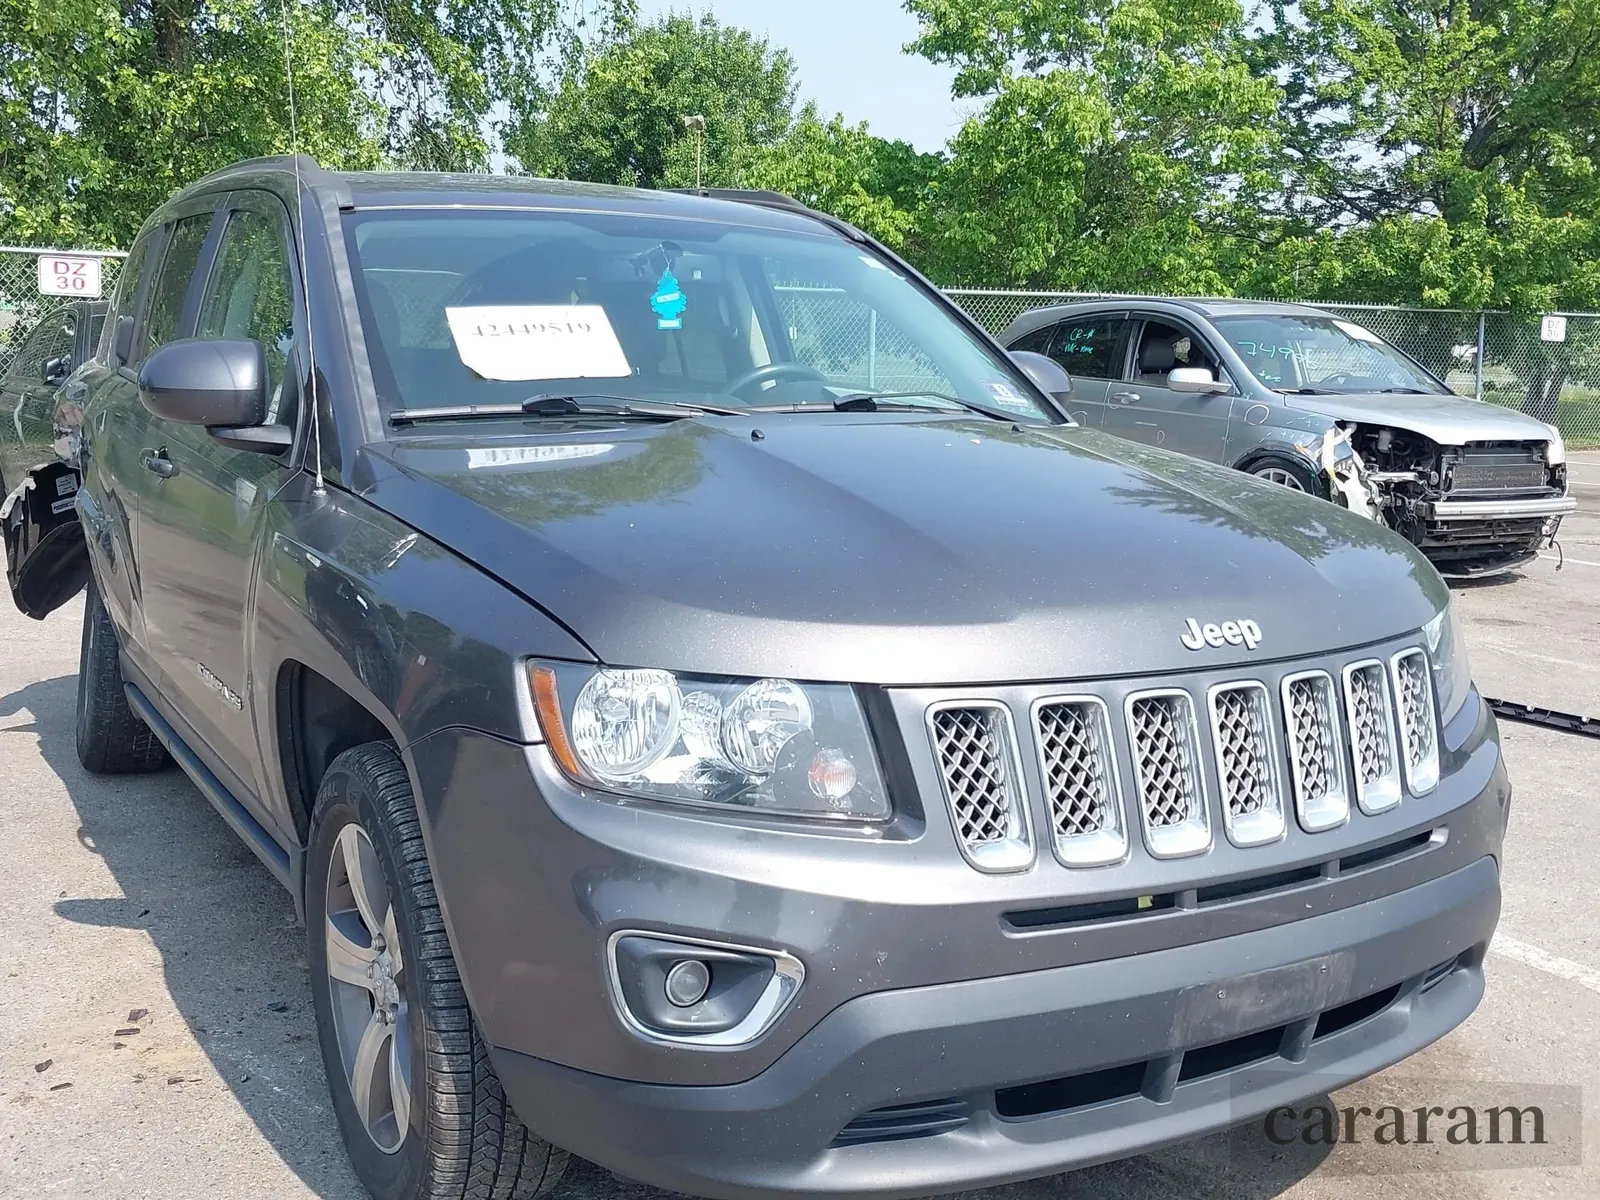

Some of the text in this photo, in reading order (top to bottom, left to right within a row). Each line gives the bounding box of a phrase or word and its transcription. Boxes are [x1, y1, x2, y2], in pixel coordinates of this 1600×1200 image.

[53, 261, 87, 276] DZ
[56, 276, 86, 290] 30
[1547, 319, 1561, 329] DZ
[1179, 617, 1262, 652] Jeep
